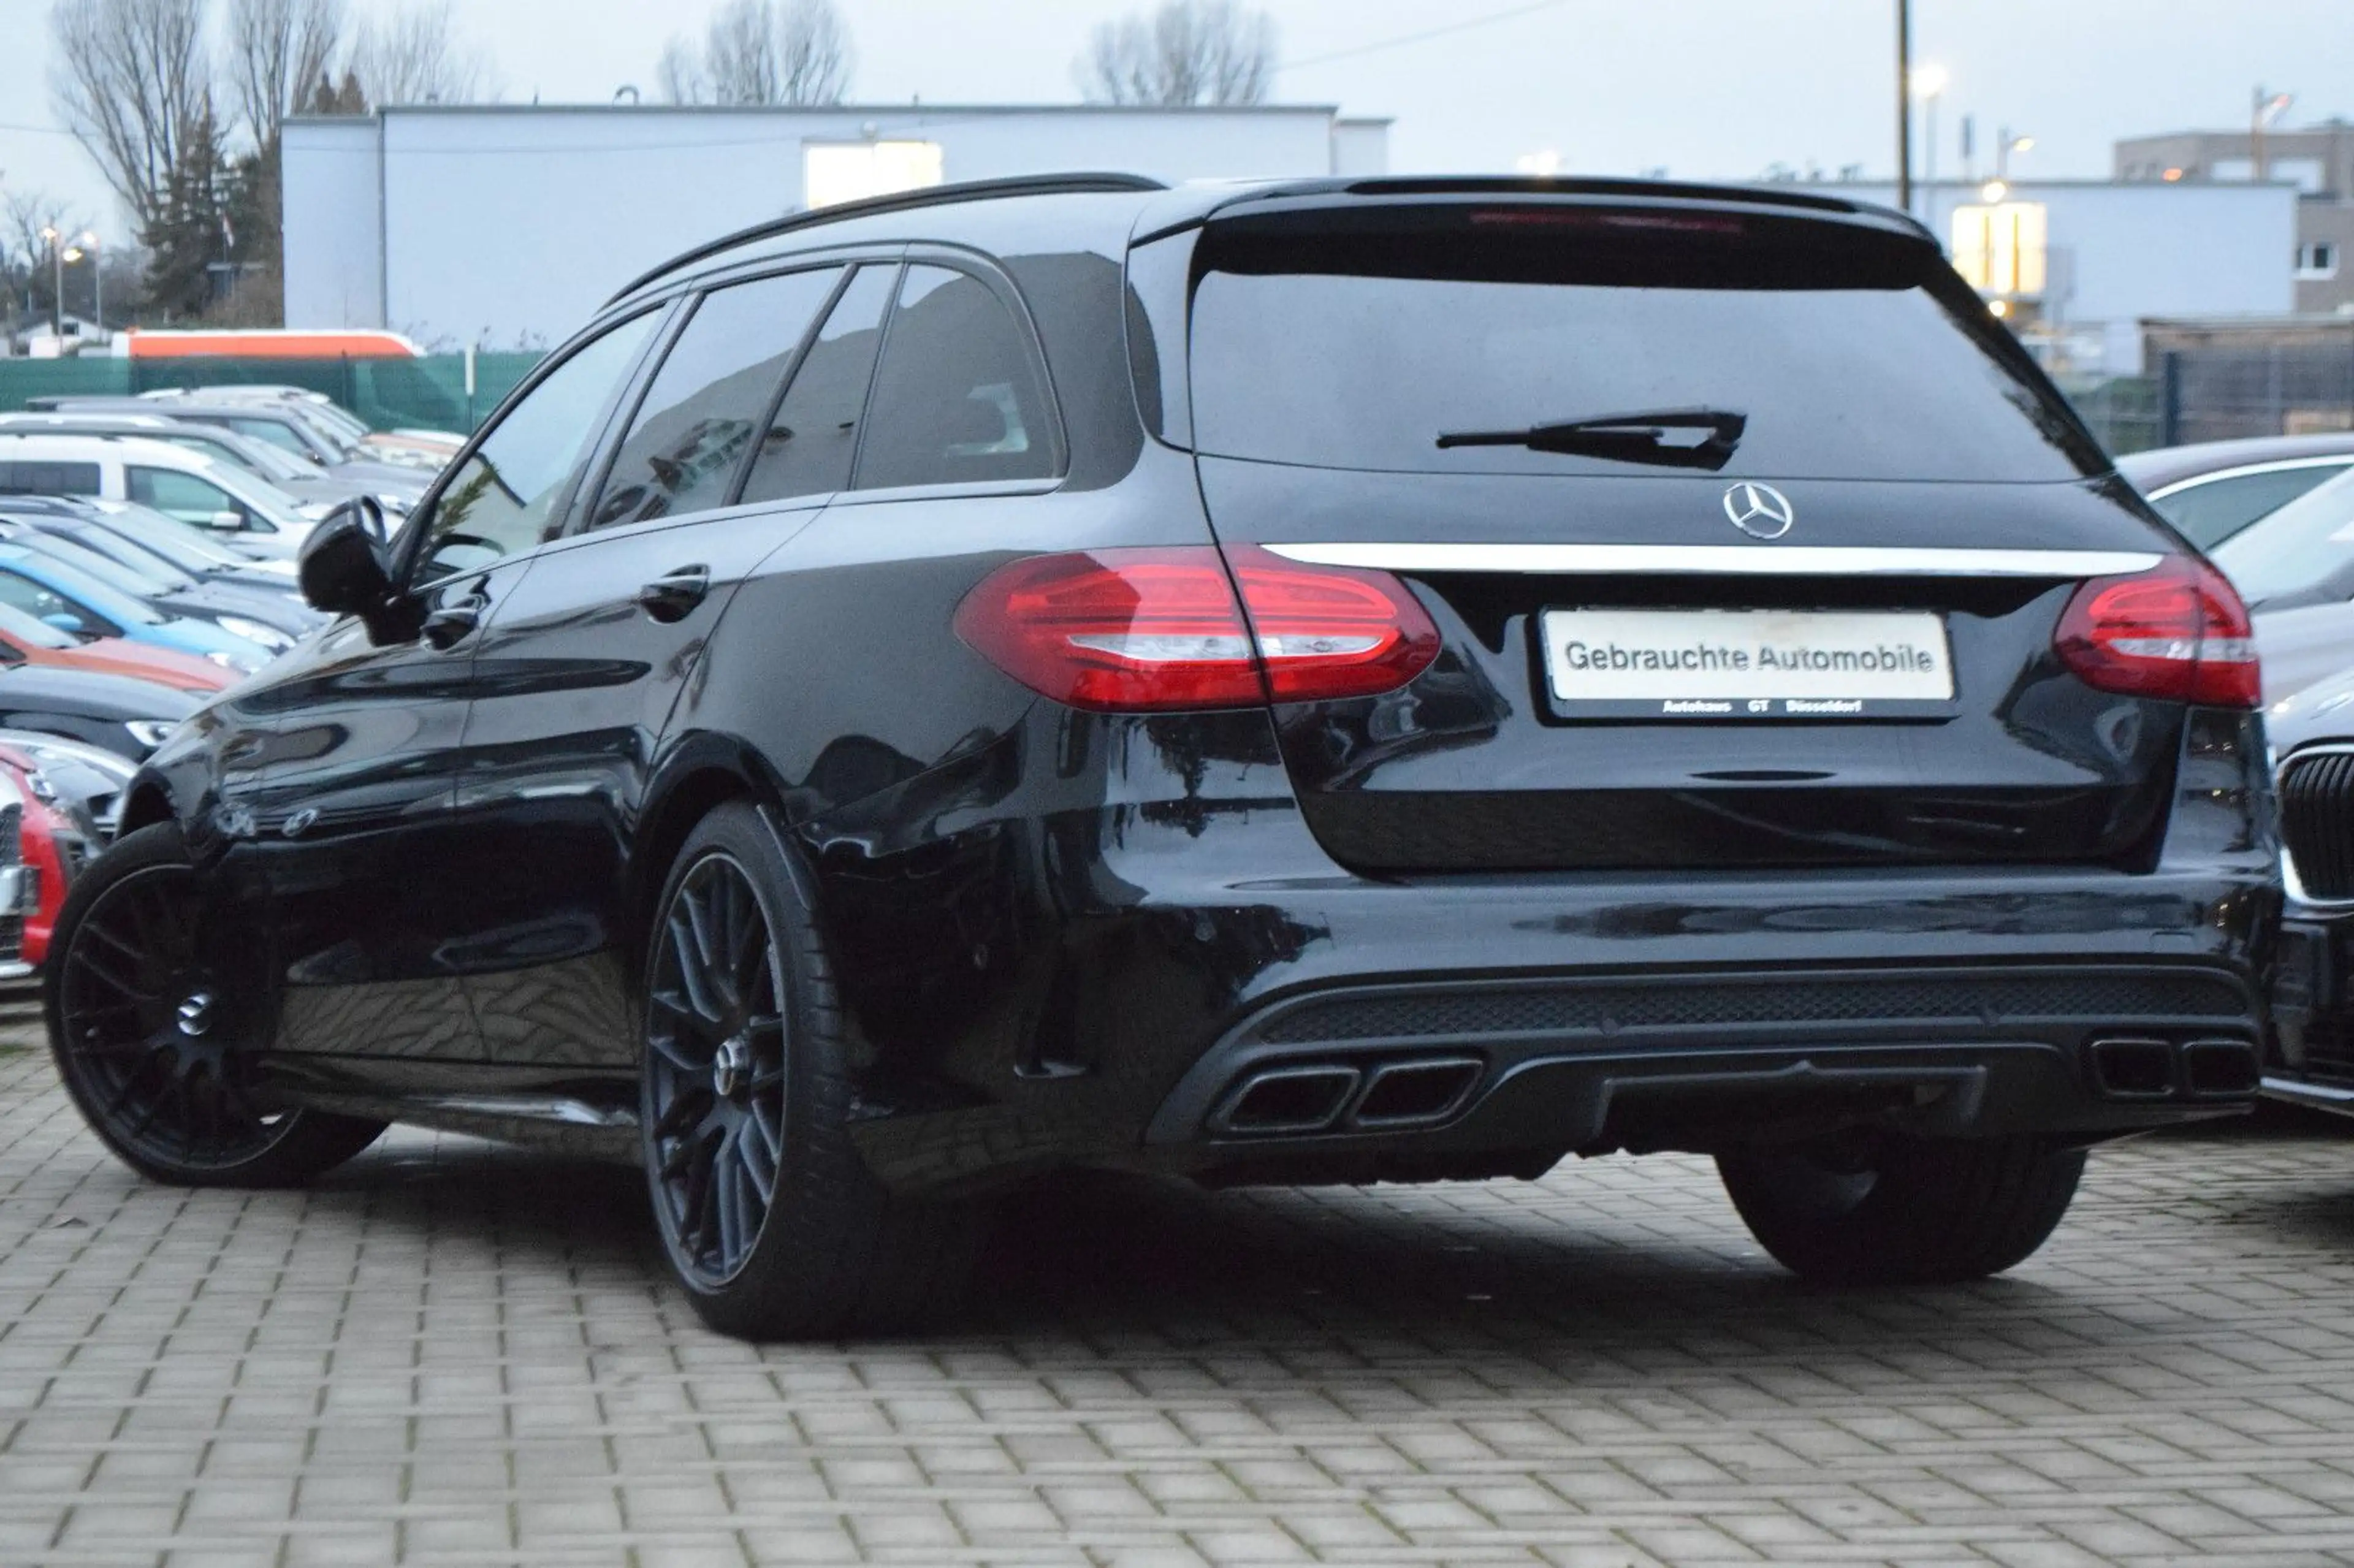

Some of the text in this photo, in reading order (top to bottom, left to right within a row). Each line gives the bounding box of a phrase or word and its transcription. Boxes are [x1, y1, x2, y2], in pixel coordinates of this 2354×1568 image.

[1565, 642, 1933, 672] Gebrauchte Automobile
[1663, 699, 1733, 712] Autohaus
[1747, 699, 1770, 712] GT
